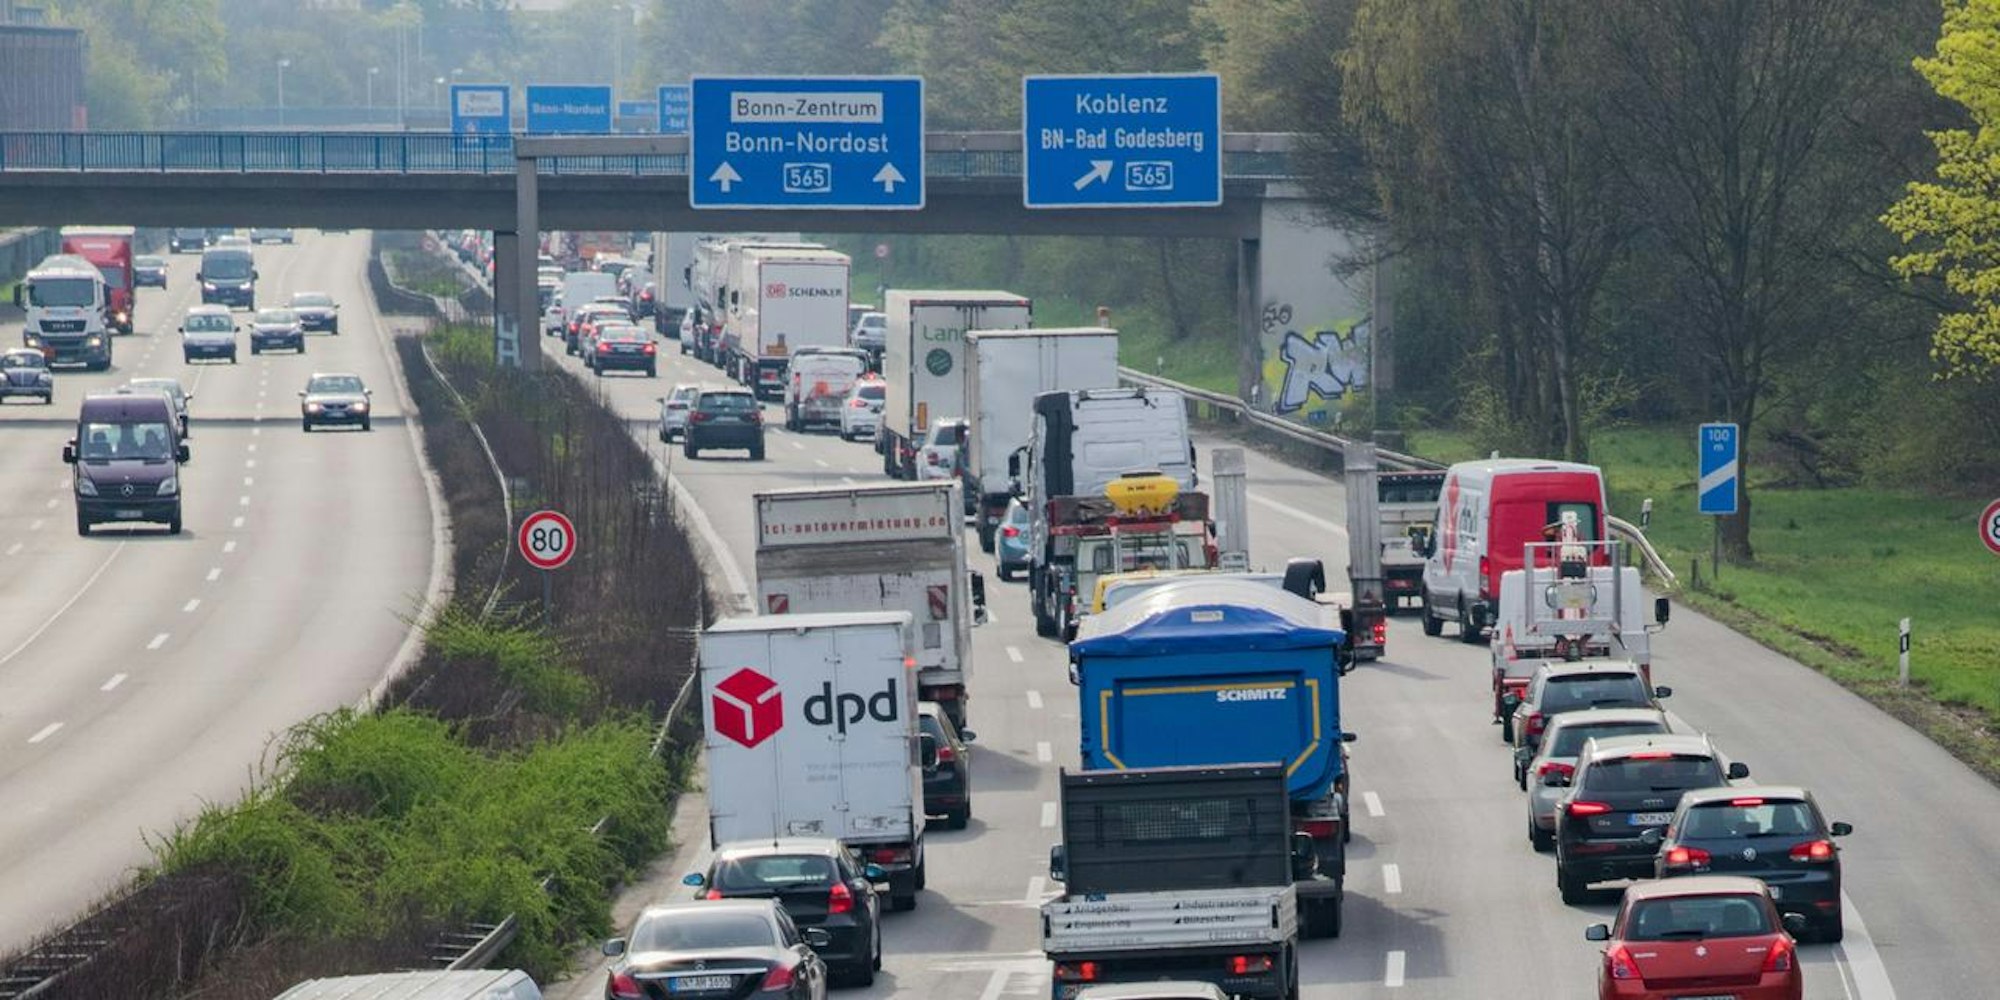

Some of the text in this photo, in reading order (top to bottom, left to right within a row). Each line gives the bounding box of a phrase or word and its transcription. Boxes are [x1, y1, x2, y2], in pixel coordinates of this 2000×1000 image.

[532, 103, 605, 115] Bonn-Nordost
[737, 99, 877, 116] Bonn-Zentrum
[1076, 93, 1168, 114] Koblenz
[726, 131, 889, 153] Bonn-Nordost
[1041, 128, 1204, 153] BN-Bad Godesberg
[791, 170, 824, 187] 565
[1132, 167, 1166, 185] 565
[789, 287, 842, 298] SCHENKER
[1708, 428, 1730, 441] 100
[1713, 443, 1724, 451] m
[532, 527, 563, 552] 80
[1216, 688, 1286, 702] SCHMITZ
[804, 678, 898, 736] dpd
[1074, 920, 1132, 930] Engineering
